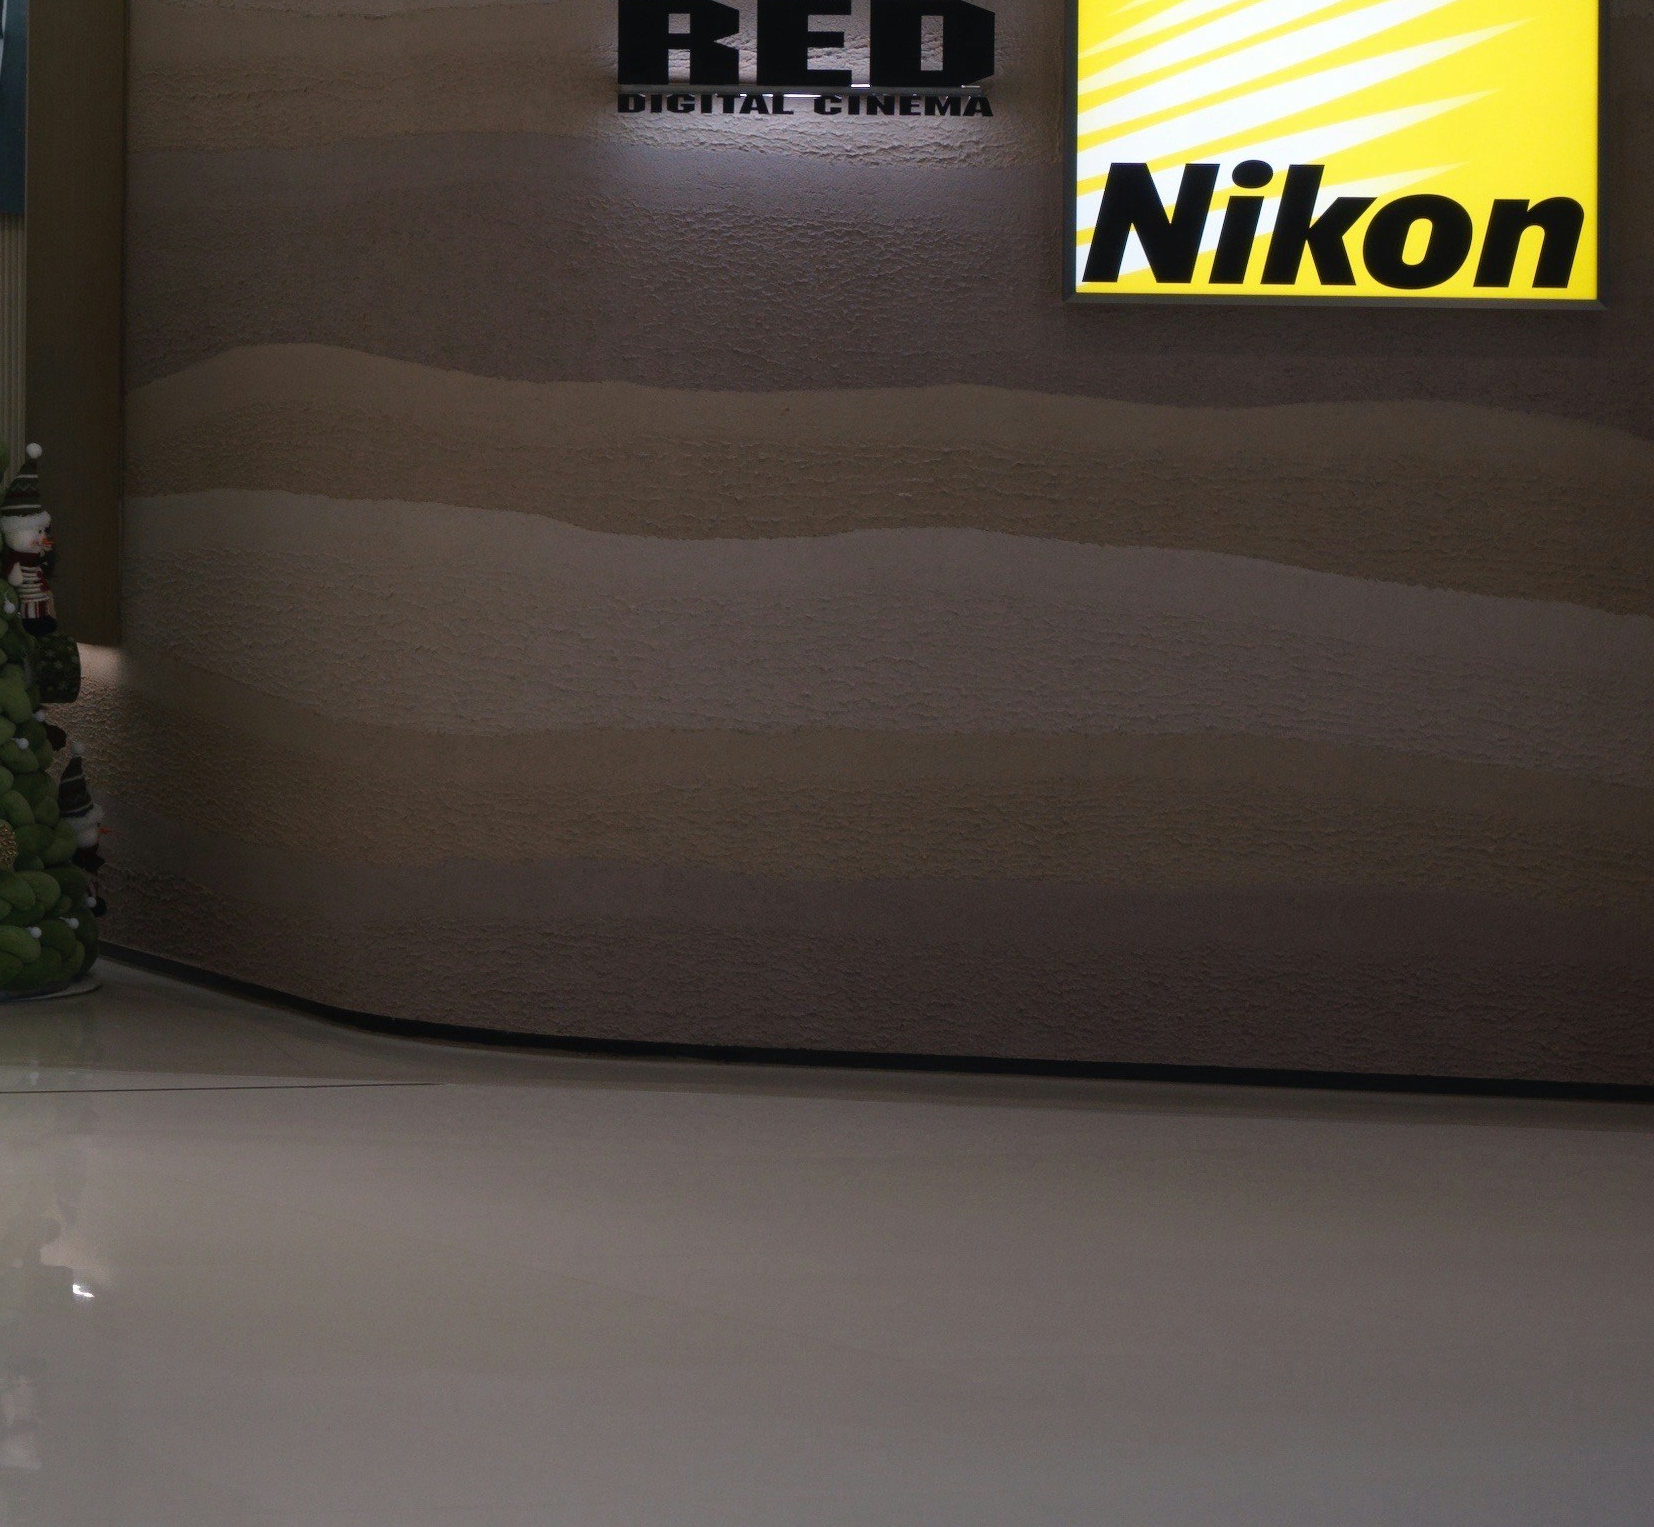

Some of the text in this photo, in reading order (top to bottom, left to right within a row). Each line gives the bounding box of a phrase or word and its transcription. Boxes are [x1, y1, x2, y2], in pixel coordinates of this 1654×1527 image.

[618, 93, 994, 117] DIGITAL CINEMA
[1082, 159, 1585, 290] Nikon
